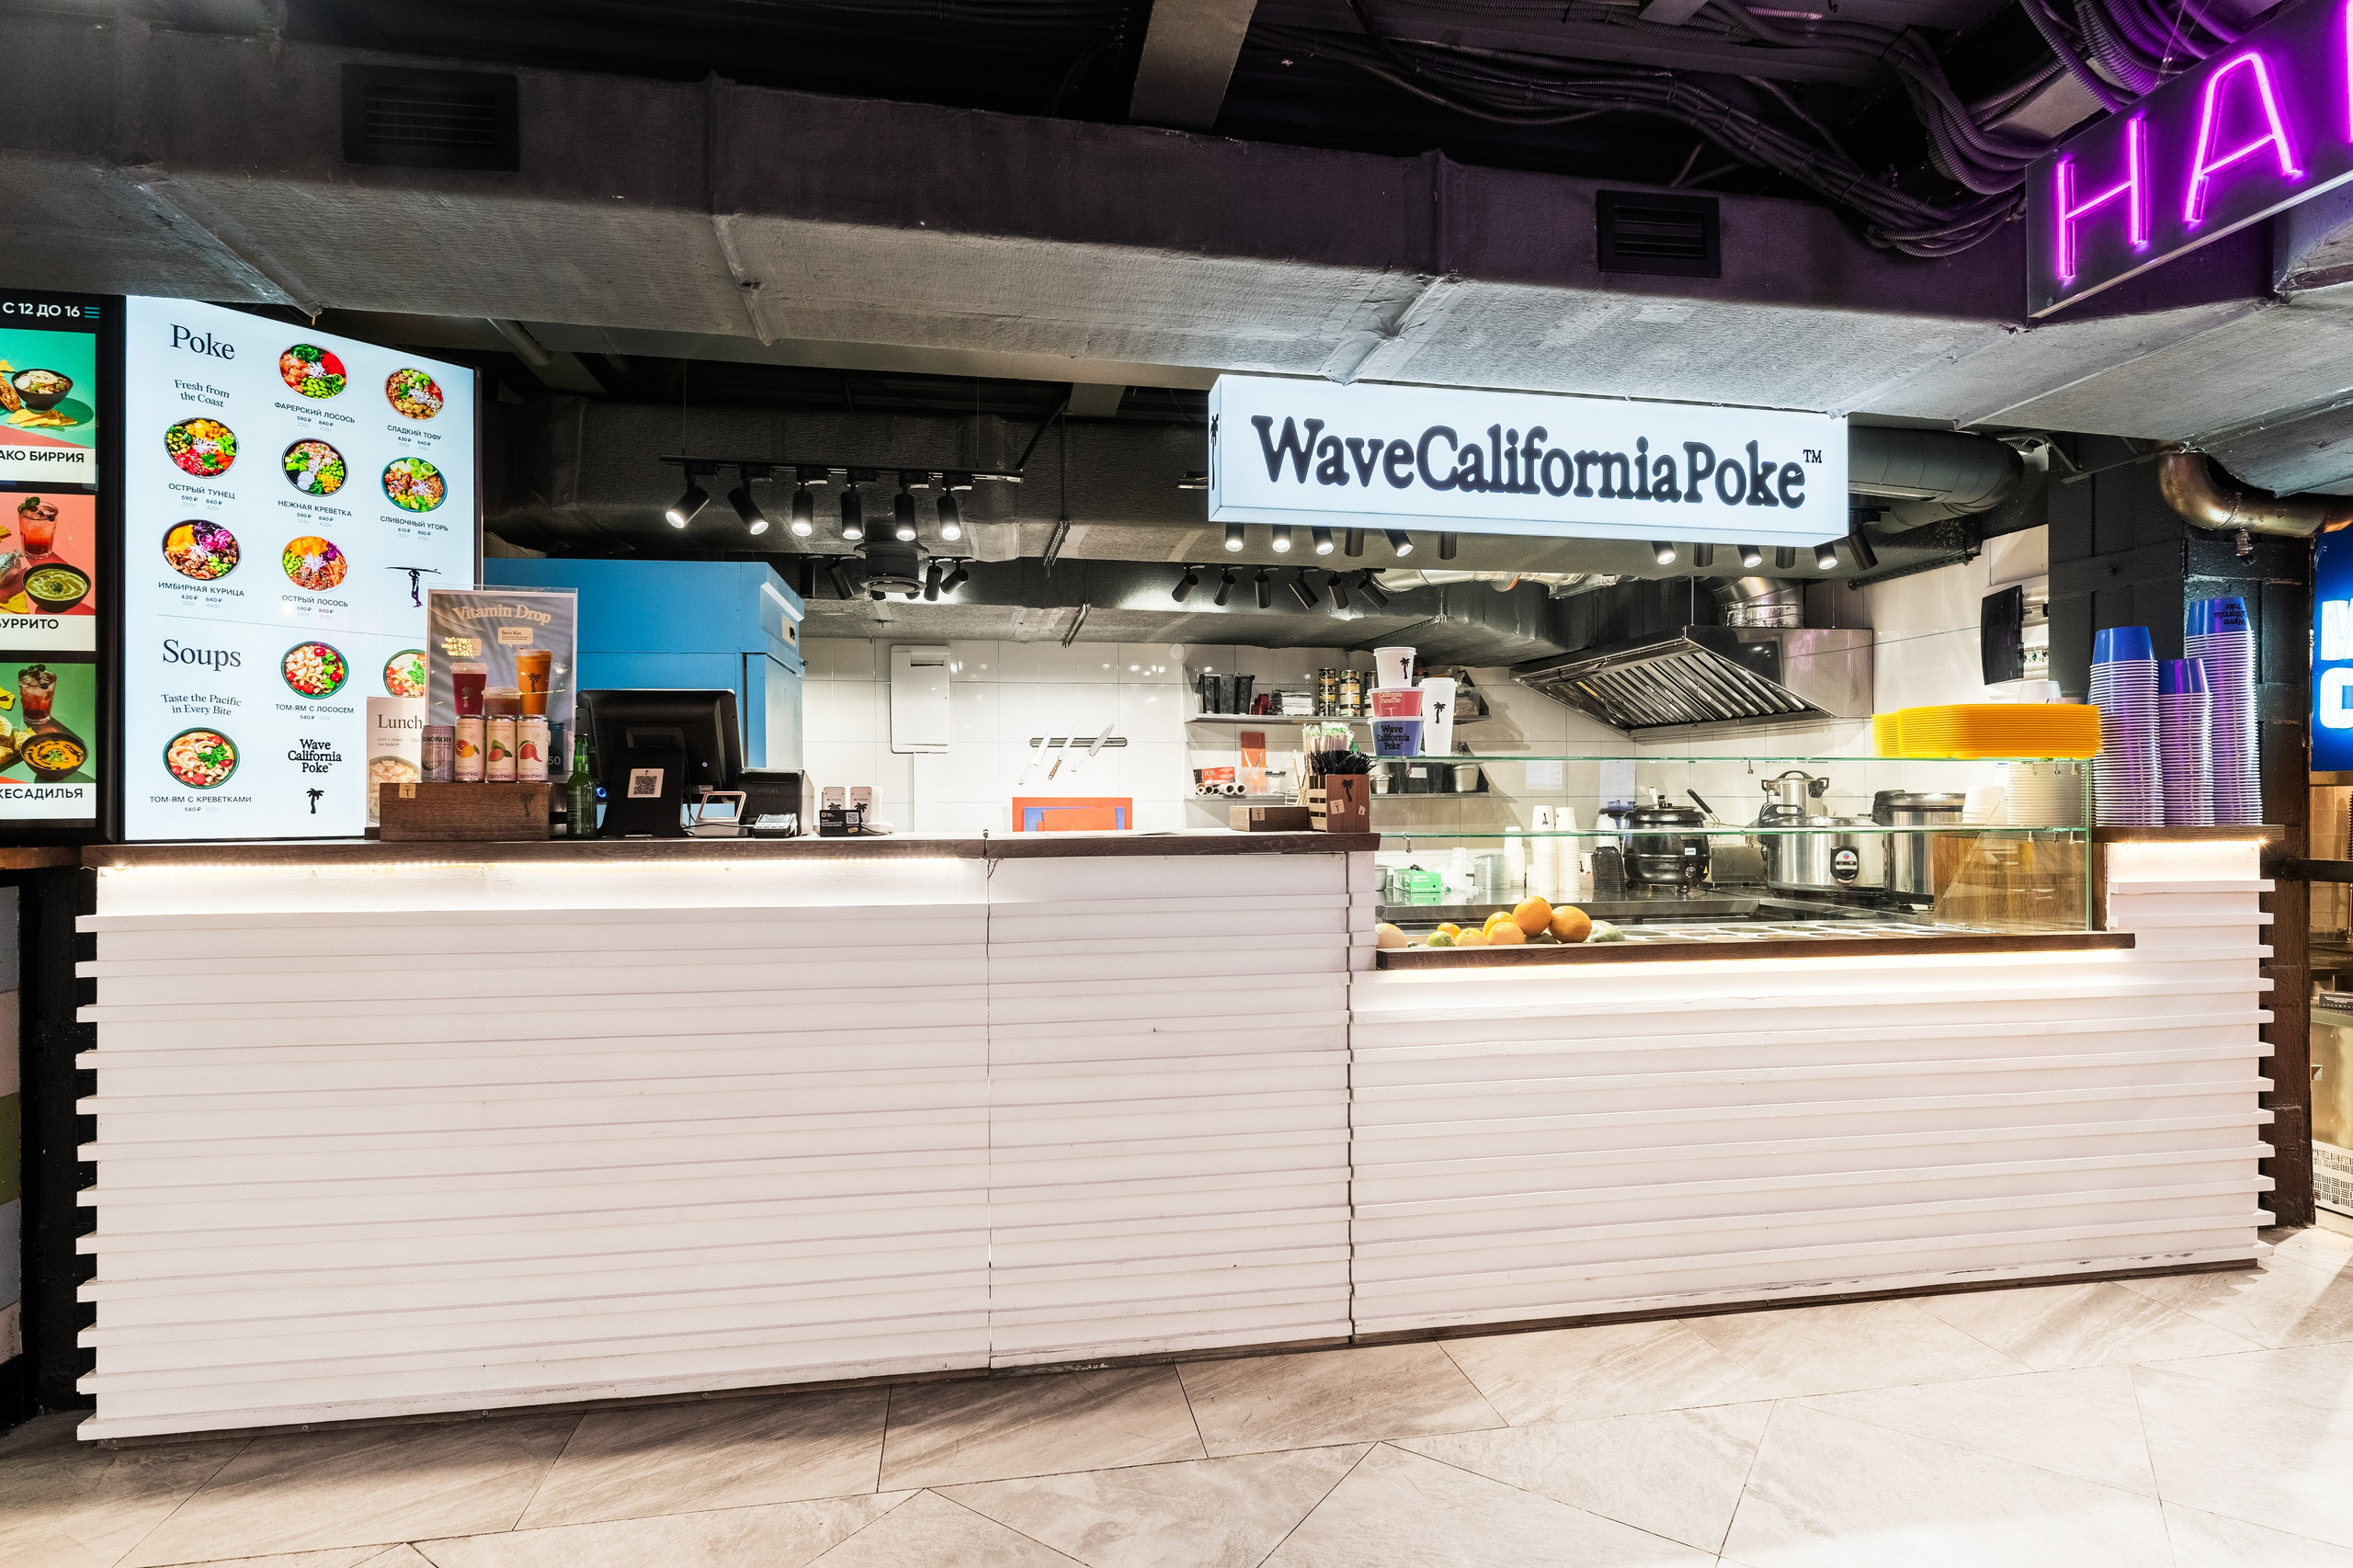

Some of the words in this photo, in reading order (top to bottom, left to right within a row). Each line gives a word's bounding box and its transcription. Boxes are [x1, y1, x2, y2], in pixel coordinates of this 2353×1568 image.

[2056, 0, 2353, 280] HA
[2, 301, 15, 313] С
[17, 302, 34, 314] 12
[36, 304, 62, 317] ДО
[64, 305, 80, 317] 16
[169, 324, 234, 359] Poke
[174, 379, 203, 392] Fresh
[206, 384, 230, 399] from
[180, 392, 196, 401] the
[198, 393, 224, 407] Coast
[274, 402, 322, 416] ФАРЕРСКИЙ
[324, 412, 356, 424] ЛОСОСЬ
[387, 425, 422, 437] СЛАДКИЙ
[423, 432, 442, 440] ТОФУ
[29, 450, 85, 463] БИРРИЯ
[168, 483, 205, 494] ОСТРЫЙ
[208, 488, 235, 499] ТУНЕЦ
[278, 500, 313, 510] НЕЖНАЯ
[314, 506, 353, 517] КРЕВЕТКА
[380, 516, 426, 528] СЛИВОЧНЫЙ
[426, 522, 449, 531] УГОРЬ
[158, 582, 208, 593] ИМБИРНАЯ
[210, 586, 244, 597] КУРИЦА
[281, 595, 314, 604] ОСТРЫЙ
[317, 598, 348, 608] ЛОСОСЬ
[451, 604, 512, 620] Vitamin
[515, 604, 551, 626] Drop
[0, 618, 59, 629] УРРИТО
[163, 639, 241, 672] Soups
[160, 693, 188, 703] Taste
[190, 693, 207, 702] the
[210, 694, 242, 707] Pacific
[275, 703, 307, 711] ТОМ-ЯМ
[171, 705, 182, 713] in
[184, 704, 210, 715] Every
[212, 705, 232, 716] Bite
[377, 713, 423, 729] Lunch
[299, 738, 331, 750] Wave
[1376, 733, 1410, 742] California
[288, 750, 342, 762] California
